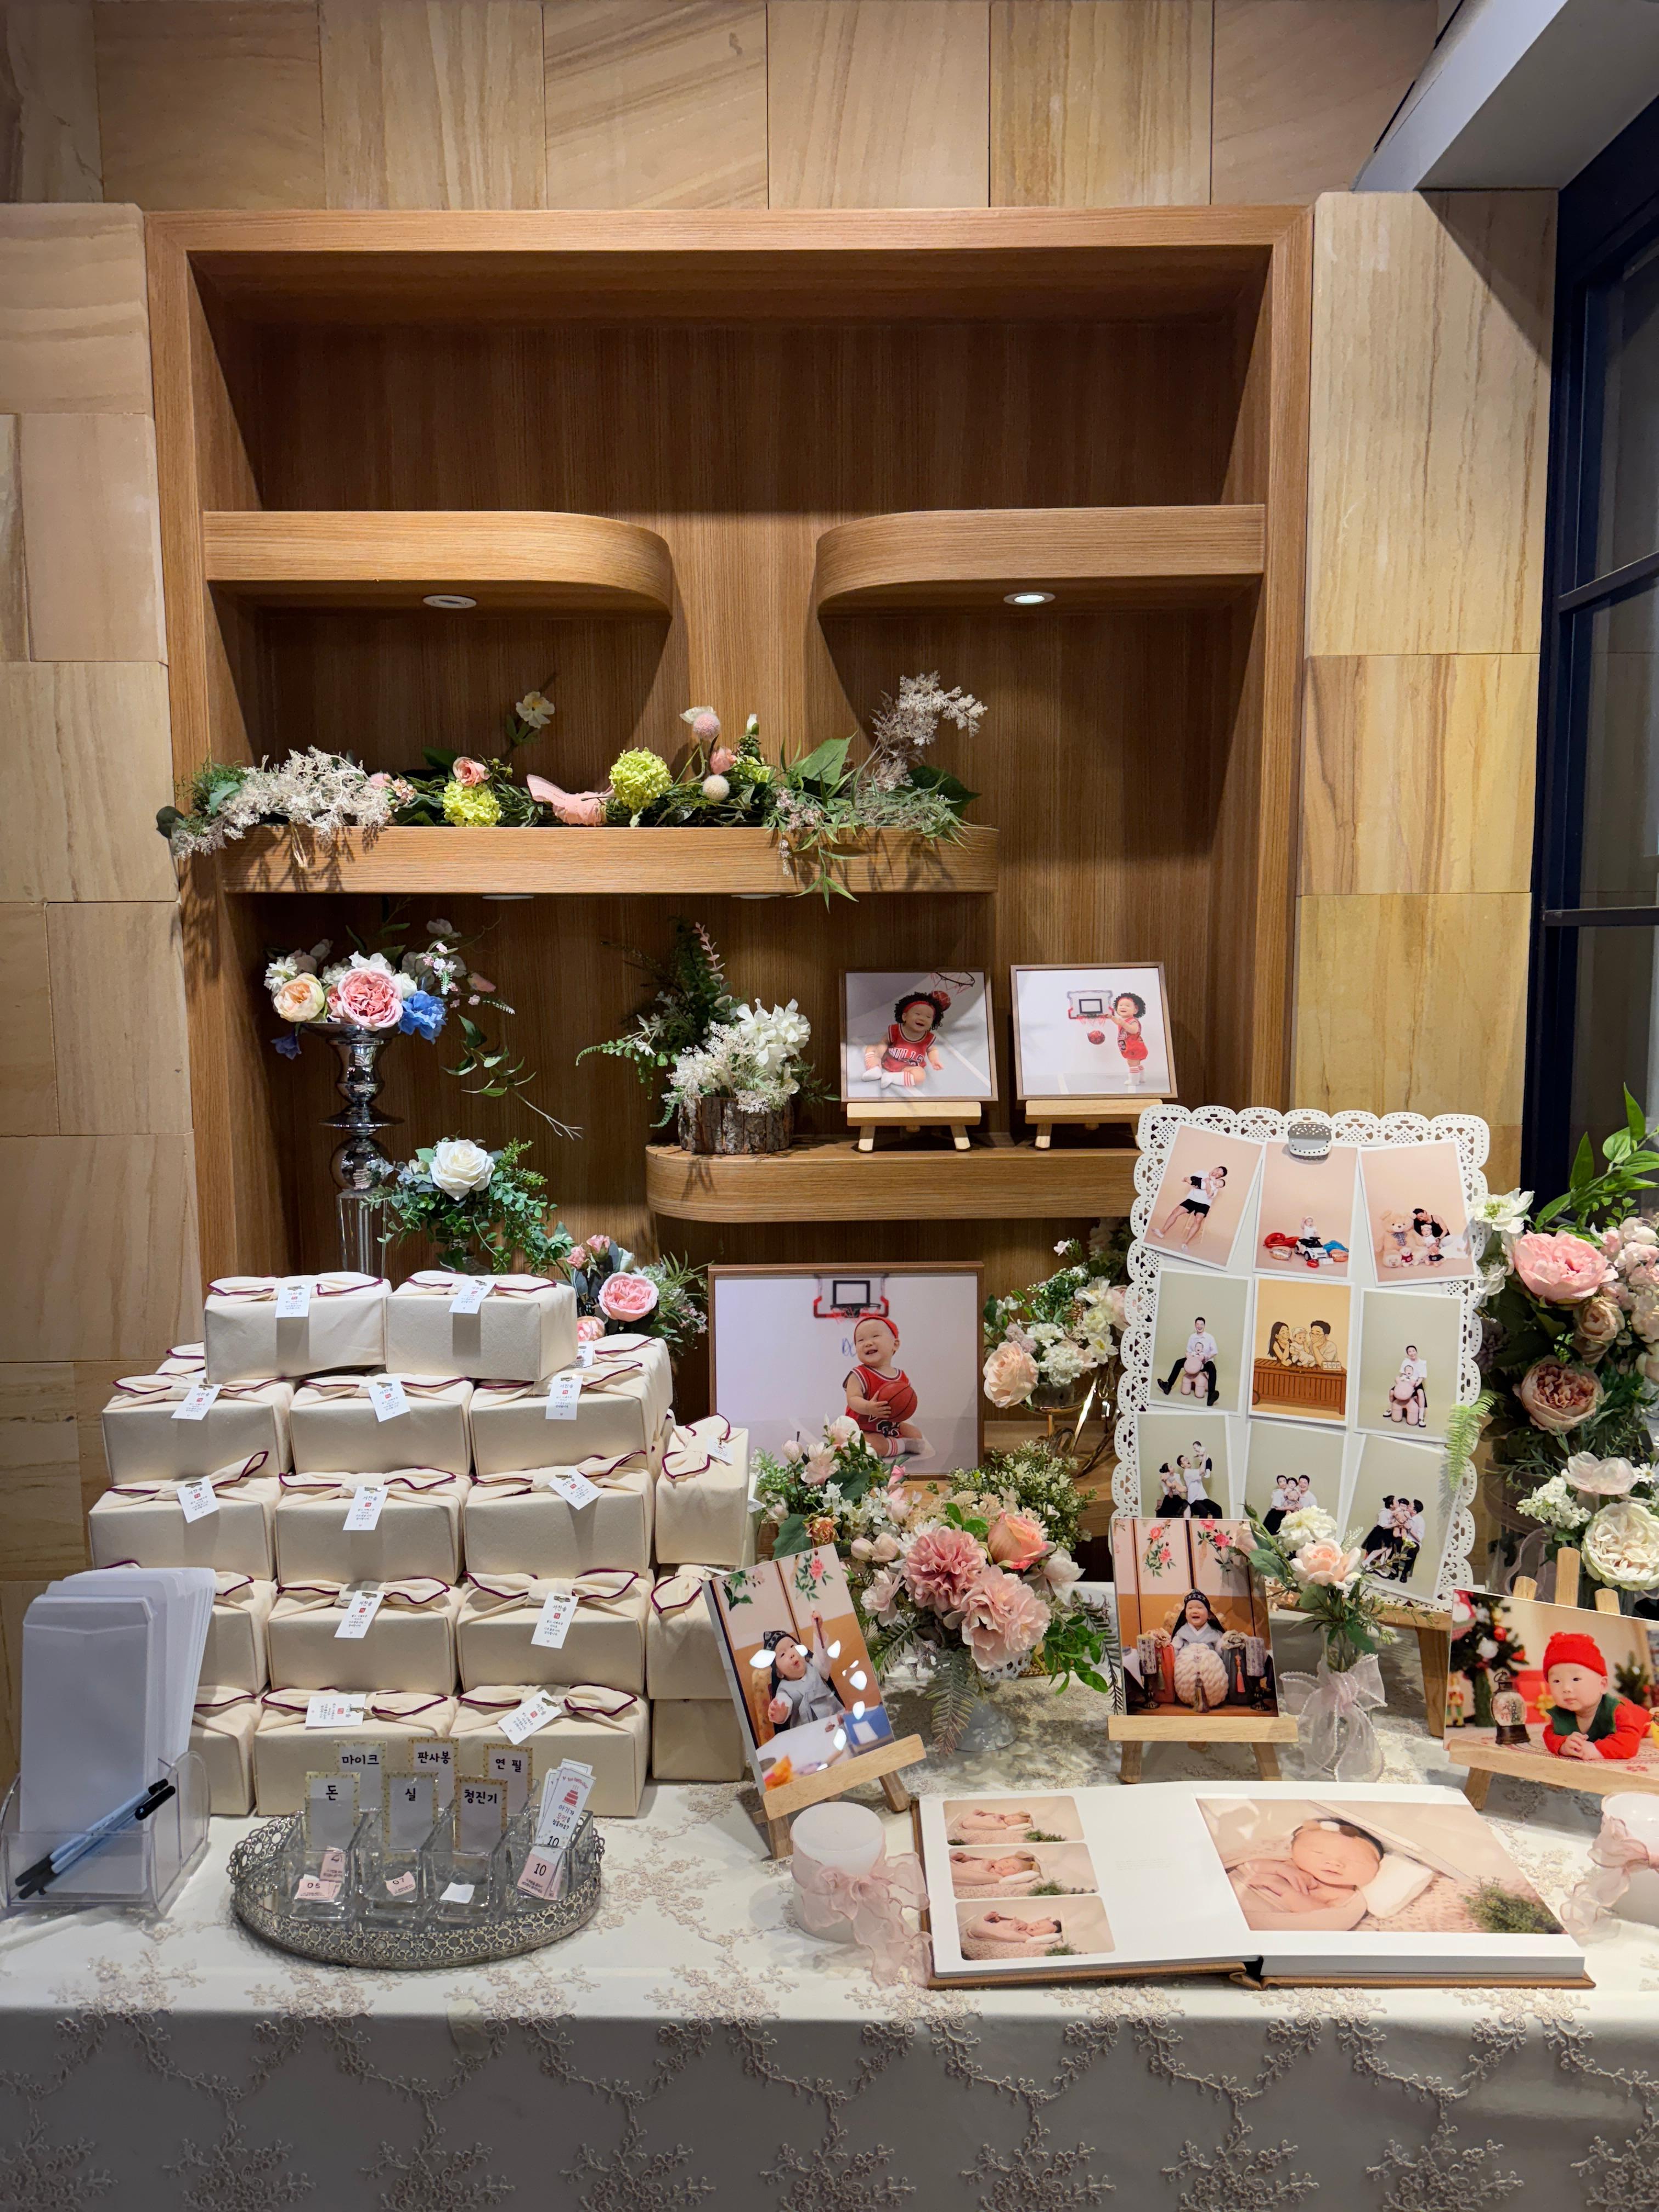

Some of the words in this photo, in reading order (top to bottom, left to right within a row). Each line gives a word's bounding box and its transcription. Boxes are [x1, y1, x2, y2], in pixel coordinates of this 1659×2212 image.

[341, 1754, 380, 1765] 마이크
[417, 1751, 451, 1764] 판사봉
[495, 1758, 505, 1770] 연
[511, 1759, 521, 1773] 필
[325, 1785, 338, 1801] 돈
[405, 1787, 416, 1801] 실
[464, 1789, 497, 1804] 청진기
[547, 1835, 560, 1847] 10
[533, 1863, 547, 1876] 10
